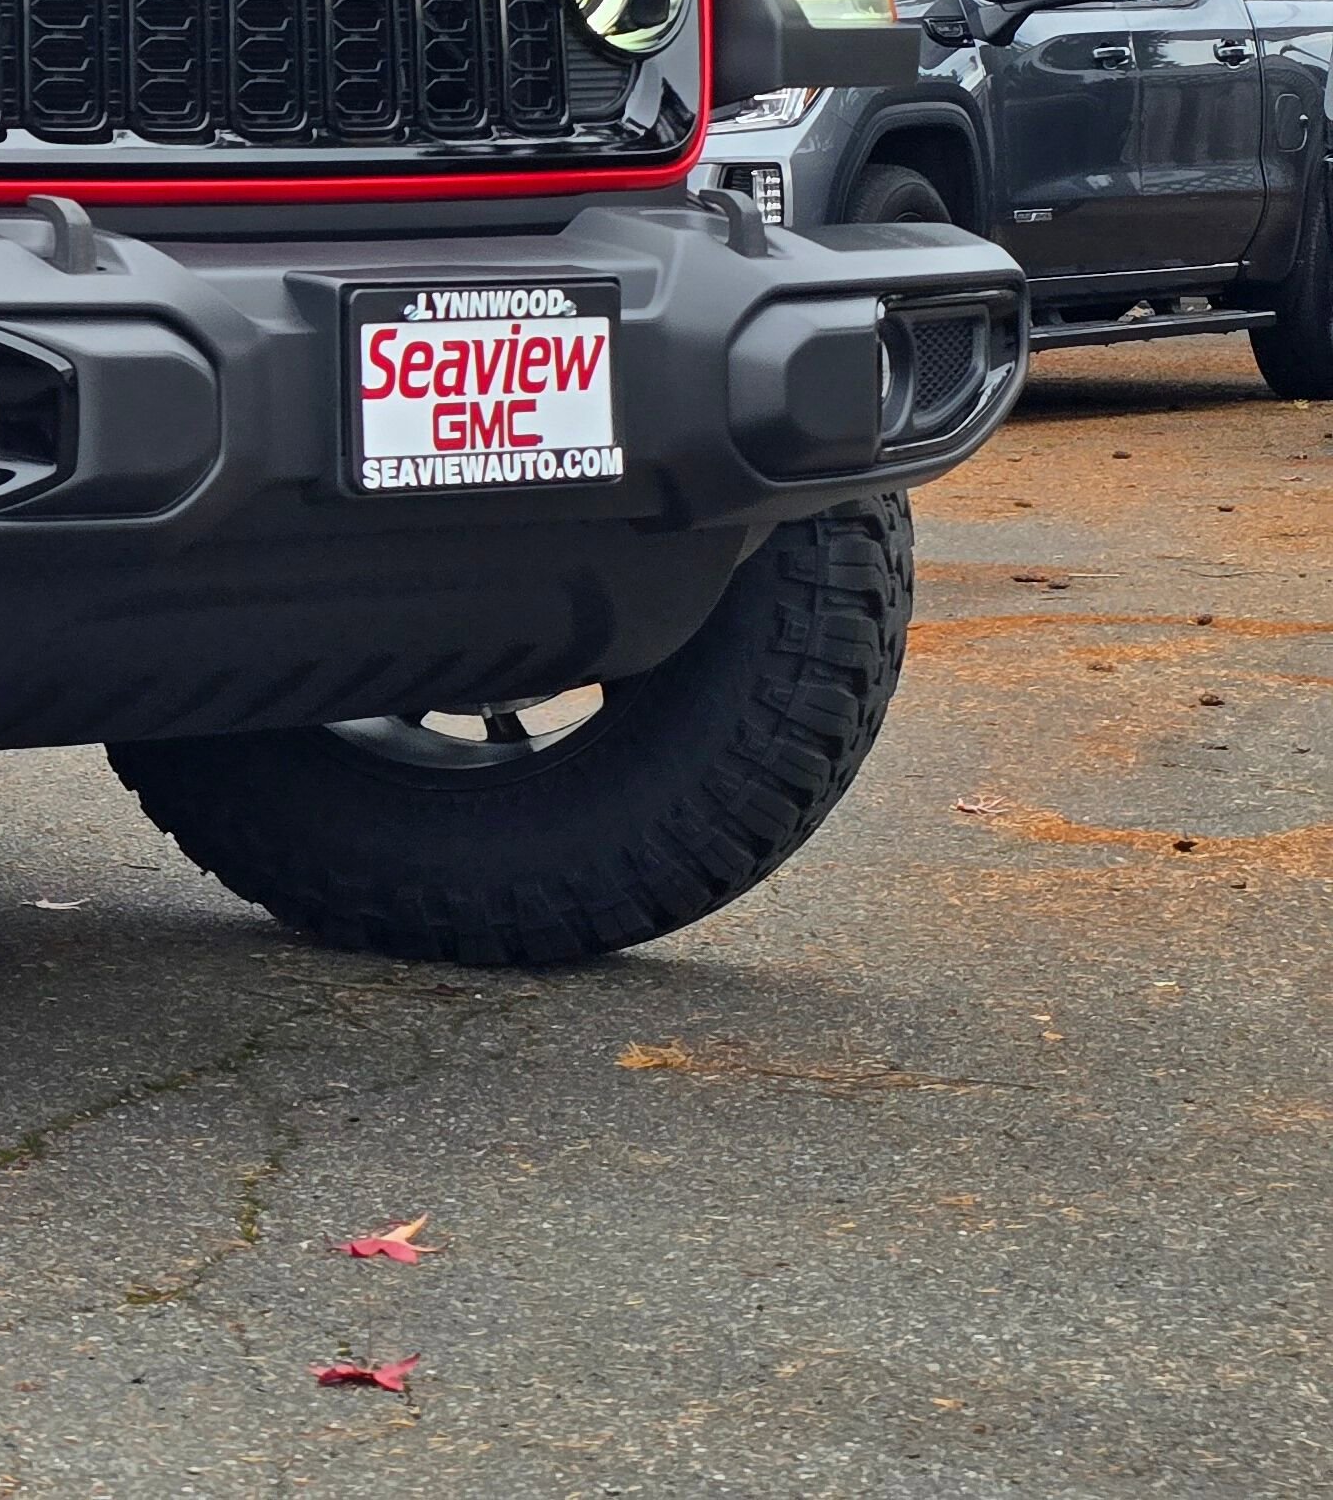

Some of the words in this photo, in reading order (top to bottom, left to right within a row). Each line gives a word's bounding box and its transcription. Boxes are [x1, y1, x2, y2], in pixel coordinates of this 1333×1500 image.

[416, 289, 565, 320] LYNNWOOD
[360, 323, 606, 400] Seaview
[432, 399, 542, 451] GMC
[362, 448, 623, 488] SEAVIEWAUTO.COM
